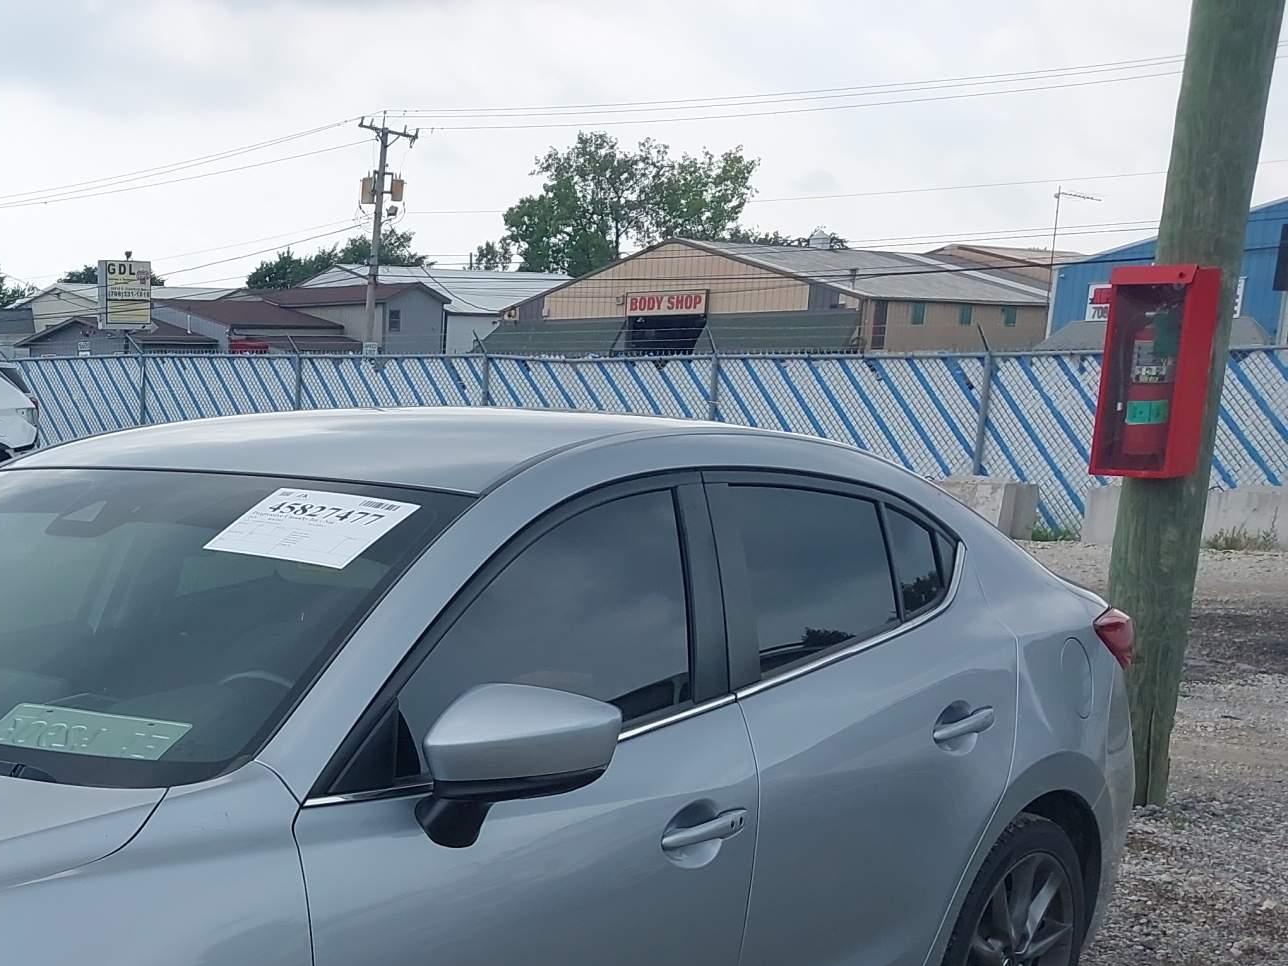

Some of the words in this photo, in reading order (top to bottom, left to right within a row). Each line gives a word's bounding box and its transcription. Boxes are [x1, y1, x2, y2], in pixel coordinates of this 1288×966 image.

[107, 263, 136, 276] GDL
[629, 295, 663, 311] BODY
[667, 294, 702, 310] SHOP
[268, 501, 386, 527] 45827477
